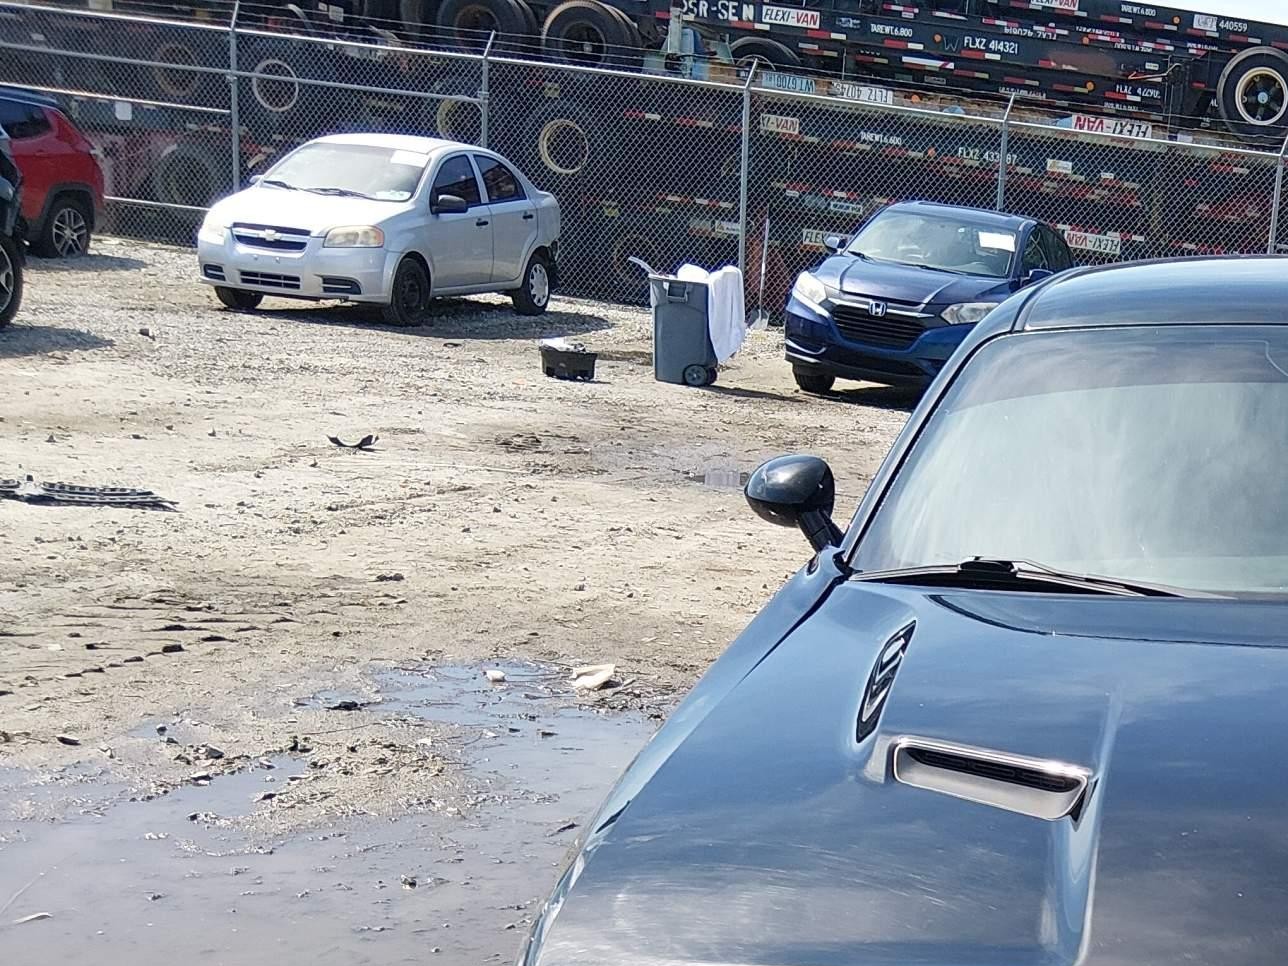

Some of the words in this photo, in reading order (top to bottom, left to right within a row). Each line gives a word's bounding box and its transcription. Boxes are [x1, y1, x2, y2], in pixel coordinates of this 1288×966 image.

[763, 7, 819, 27] FLEXI-VAN
[964, 36, 986, 50] FLXZ
[867, 88, 888, 103] FLTZ
[1074, 115, 1149, 138] FLEXI-VAN
[983, 151, 1017, 166] 43387
[1066, 232, 1120, 253] FLEXI-VAN
